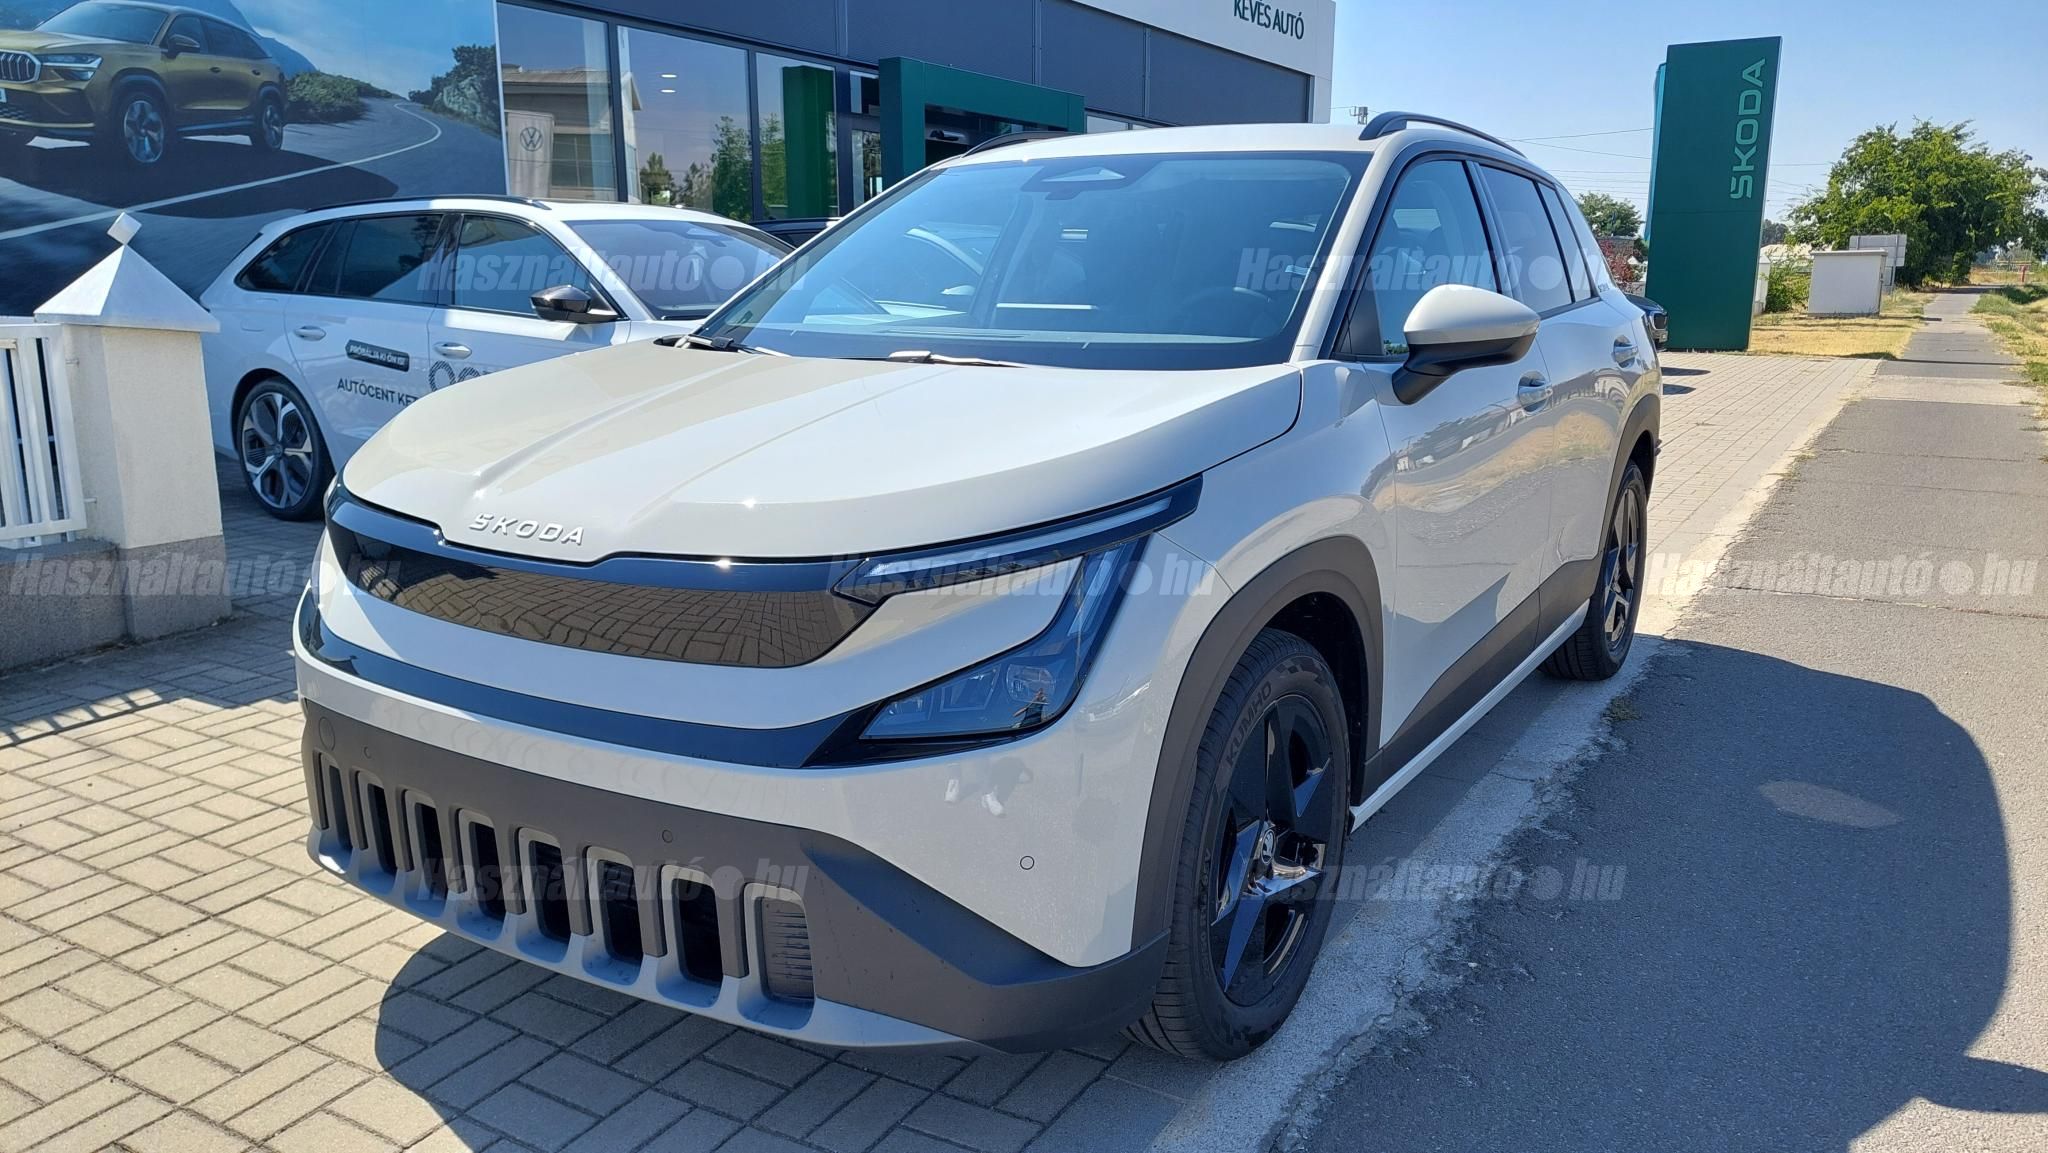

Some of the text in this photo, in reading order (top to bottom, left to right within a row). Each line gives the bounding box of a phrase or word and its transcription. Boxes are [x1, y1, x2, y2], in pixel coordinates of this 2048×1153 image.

[1272, 9, 1304, 40] AUTÓ
[337, 378, 396, 403] AUTÓCENT
[1227, 681, 1271, 766] KUMHO
